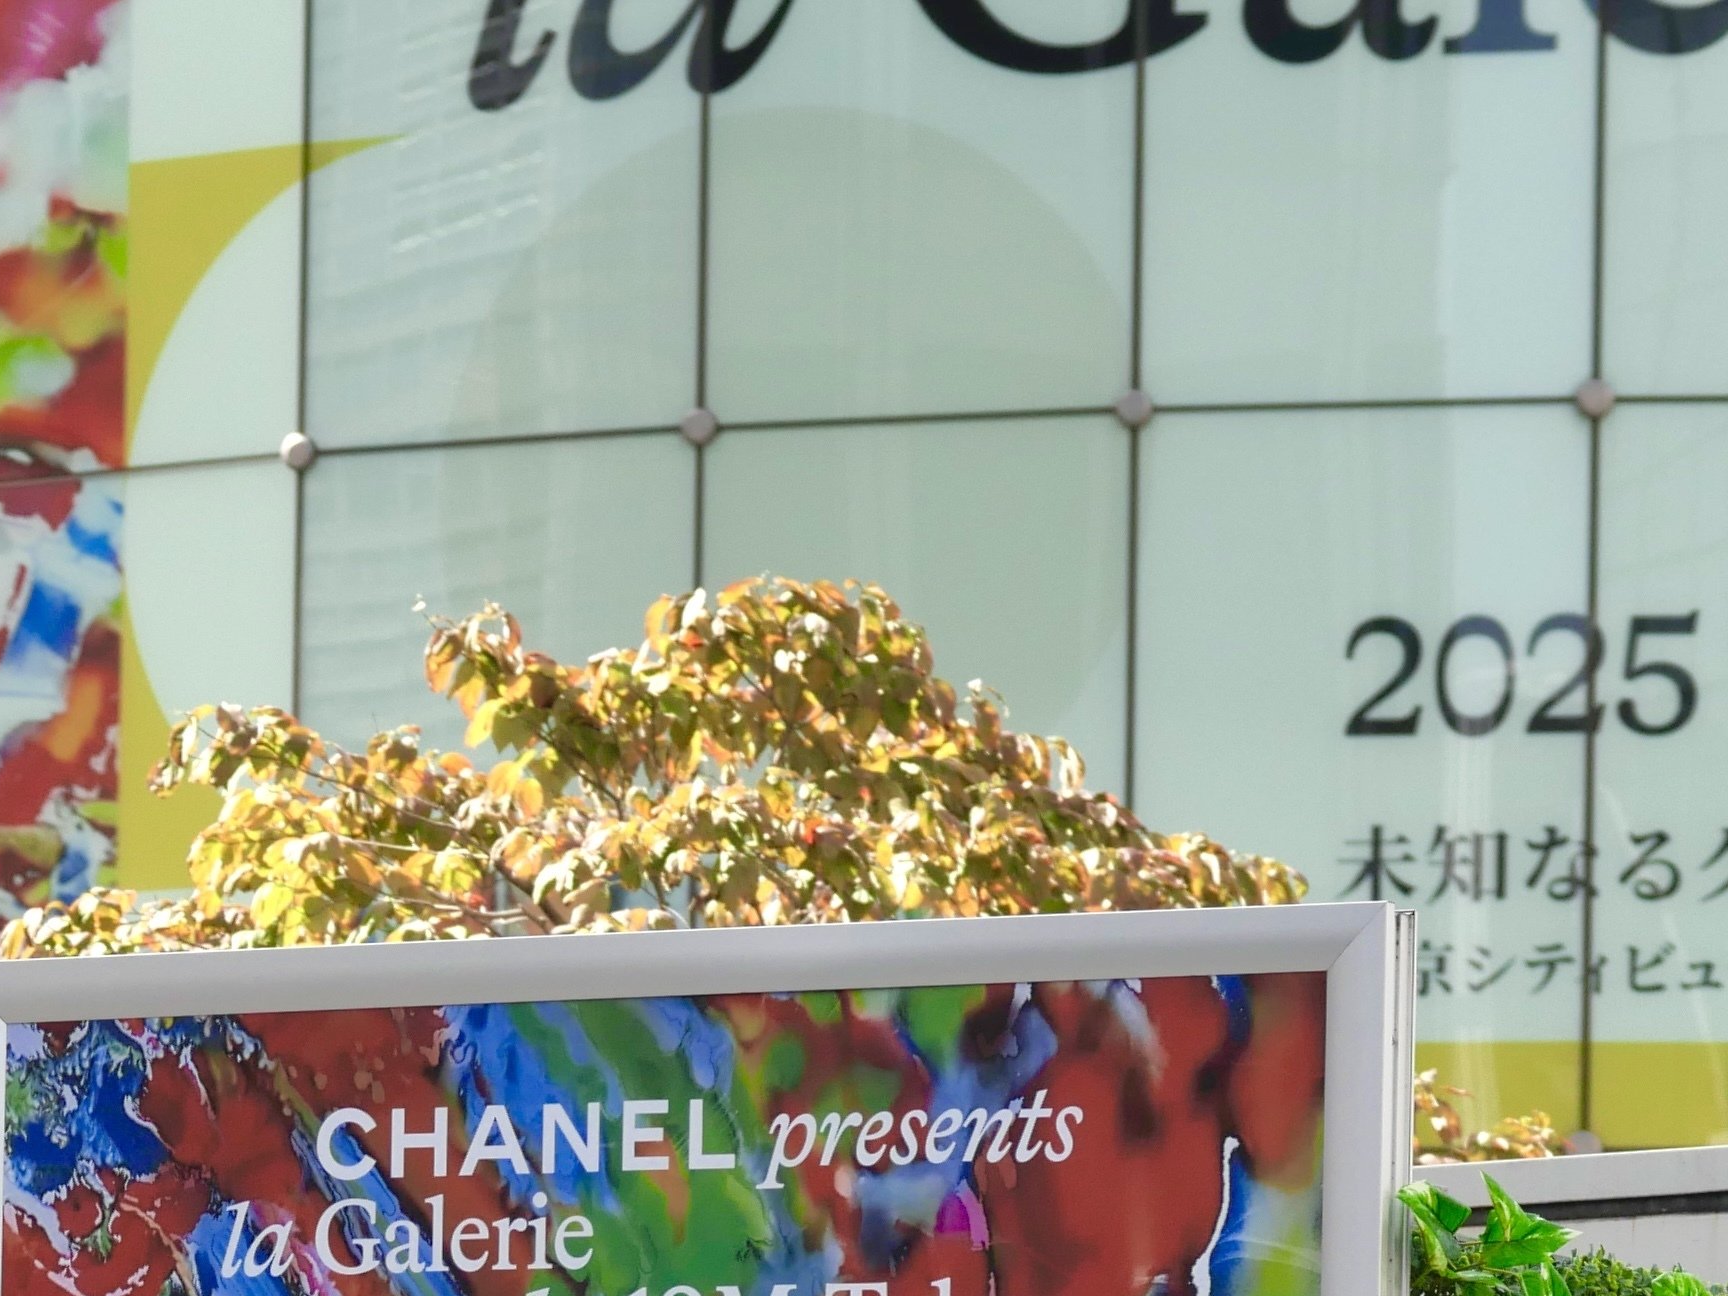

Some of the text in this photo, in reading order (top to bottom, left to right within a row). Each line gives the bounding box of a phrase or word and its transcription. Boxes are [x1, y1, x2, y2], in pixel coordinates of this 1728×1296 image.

[1344, 607, 1701, 737] 2025
[316, 1088, 1084, 1190] CHANEL presents
[221, 1191, 594, 1279] la Galerie
